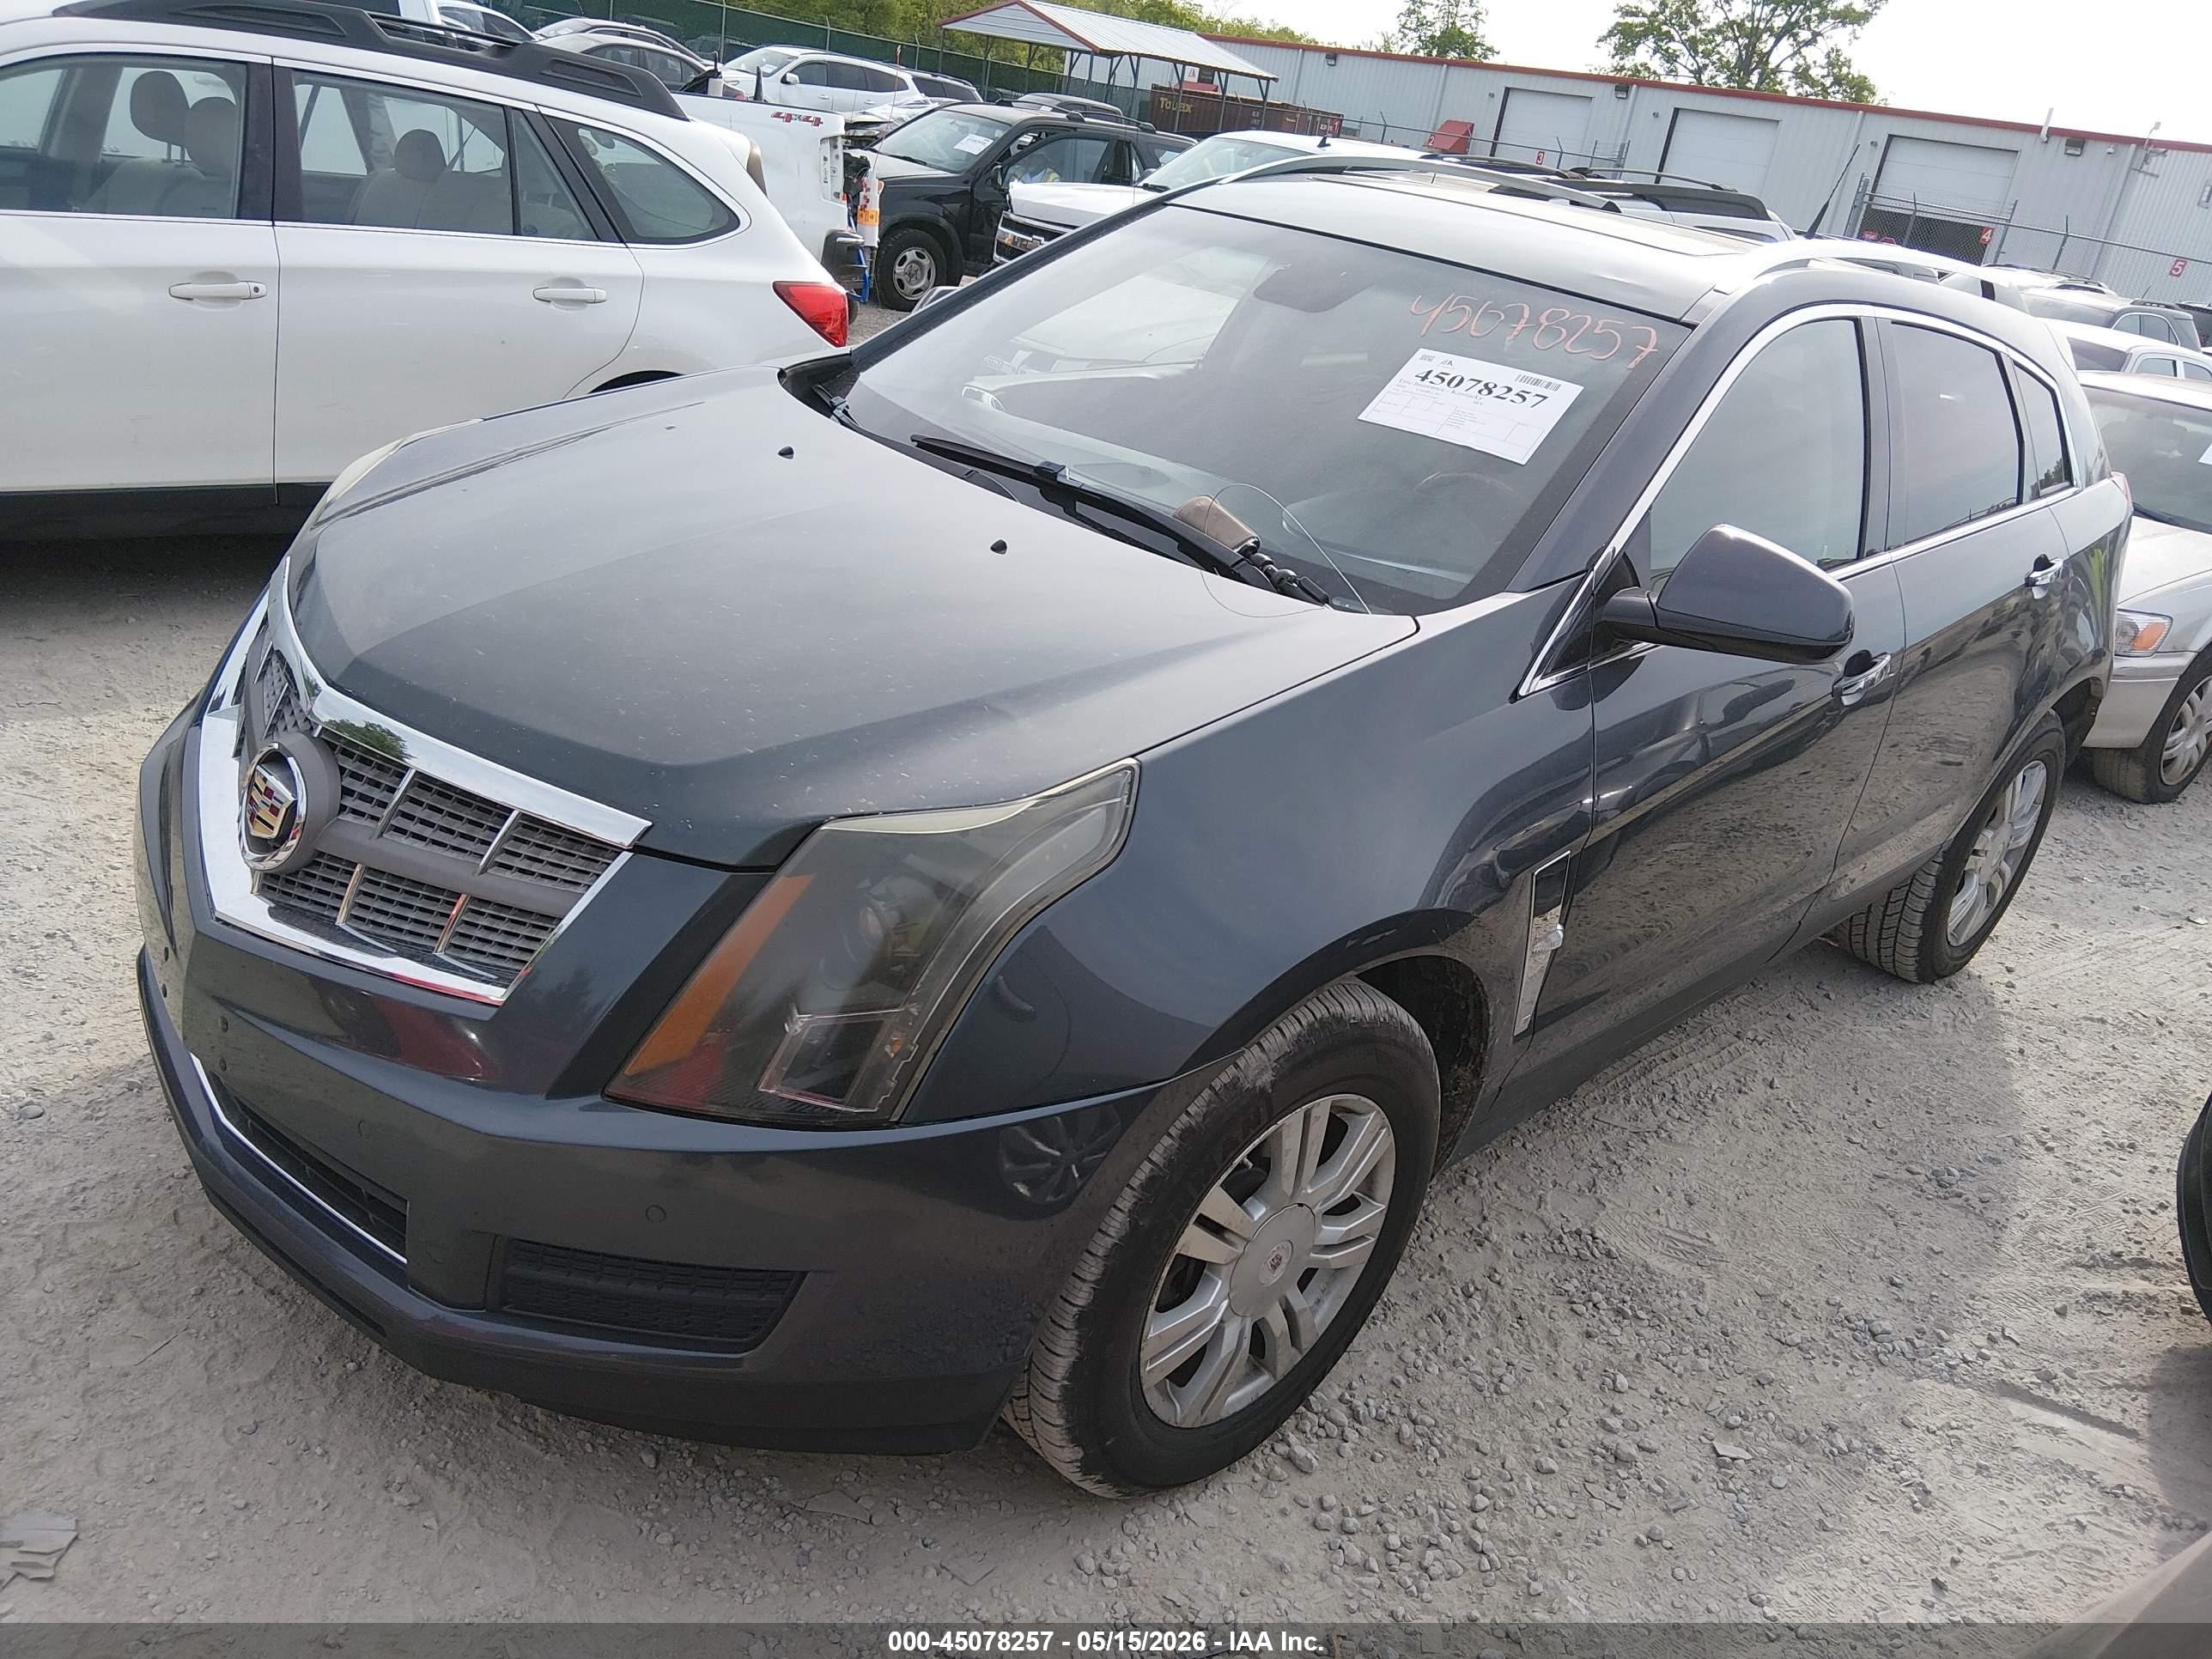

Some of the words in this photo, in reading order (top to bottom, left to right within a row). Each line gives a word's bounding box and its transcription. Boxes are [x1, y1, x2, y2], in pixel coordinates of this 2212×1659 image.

[1429, 137, 1435, 146] 2
[1537, 152, 1543, 164] 3
[1982, 228, 1992, 242] 4
[2172, 261, 2185, 275] 5
[1414, 369, 1549, 409] 45078257
